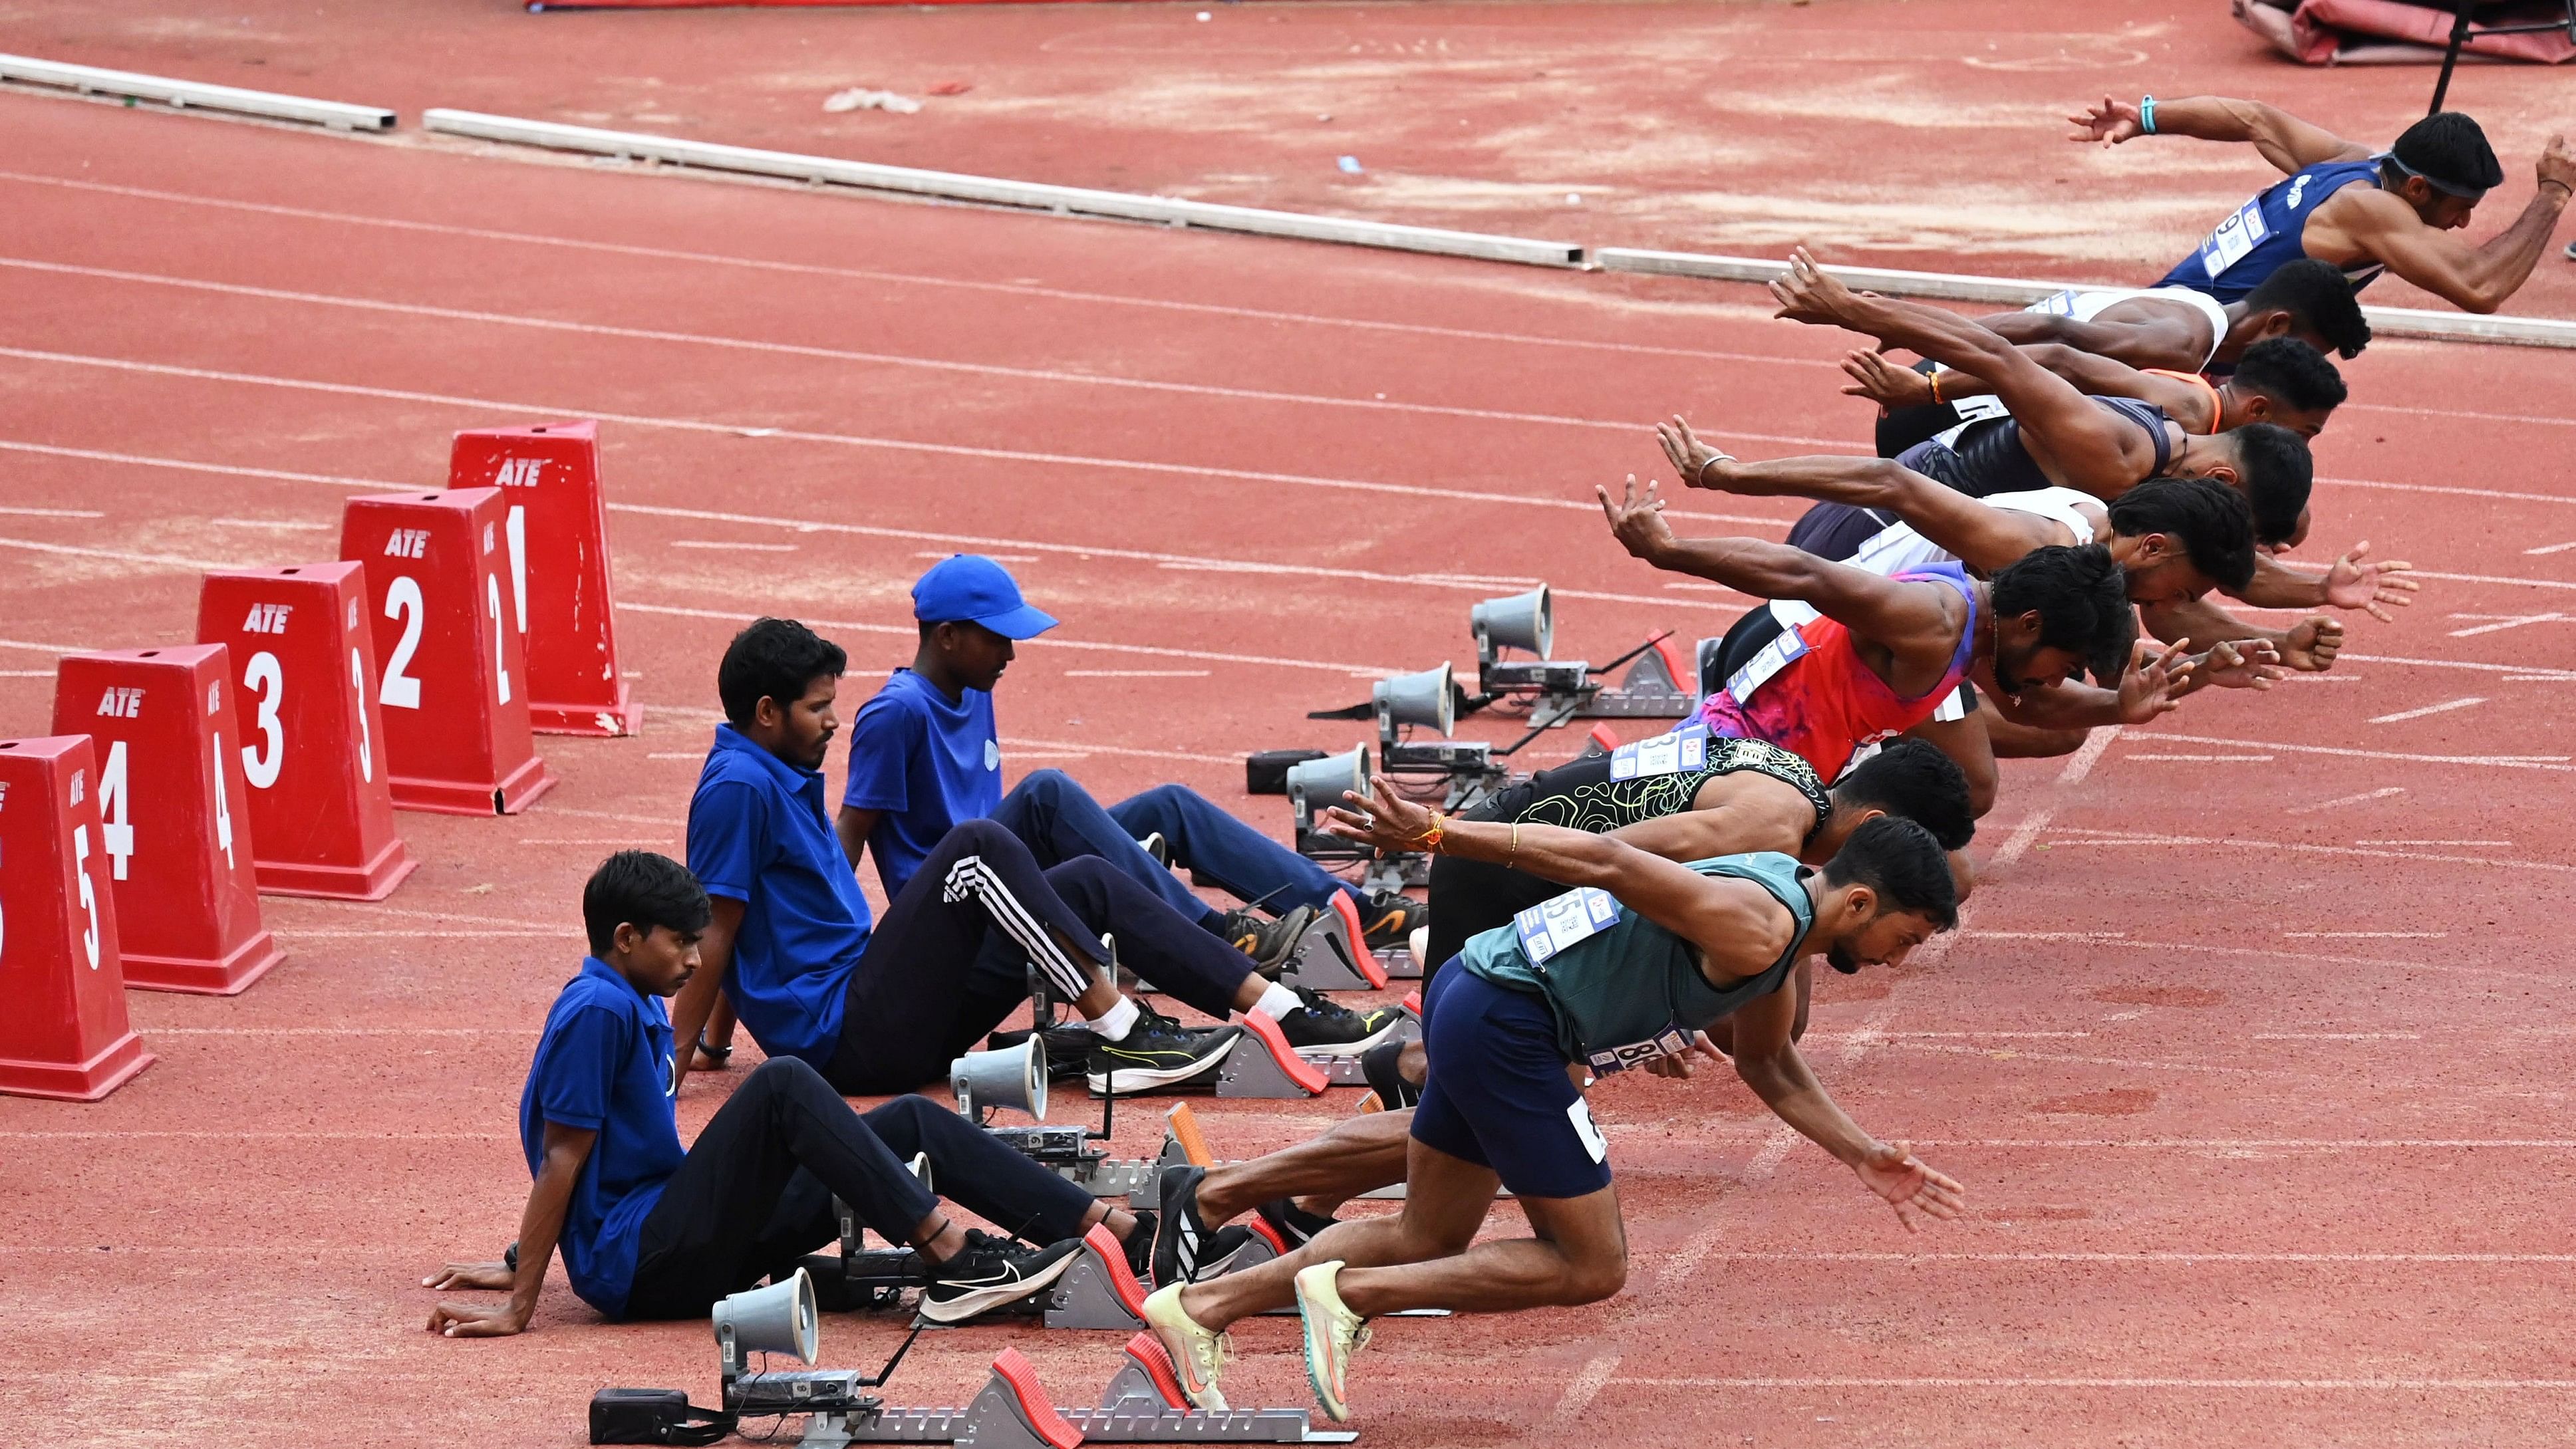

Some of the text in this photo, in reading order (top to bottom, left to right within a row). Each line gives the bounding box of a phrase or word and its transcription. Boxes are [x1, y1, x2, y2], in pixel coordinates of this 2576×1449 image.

[495, 457, 543, 487] ATE
[384, 529, 430, 559] ATE
[505, 505, 527, 634] 1
[242, 603, 293, 634] ATE
[379, 576, 424, 710] 2
[488, 572, 509, 706] 2
[96, 686, 142, 718] ATE
[241, 651, 284, 789] 3
[351, 646, 372, 784] 3
[98, 741, 134, 881] 4
[213, 731, 235, 871] 4
[73, 823, 100, 971] 5
